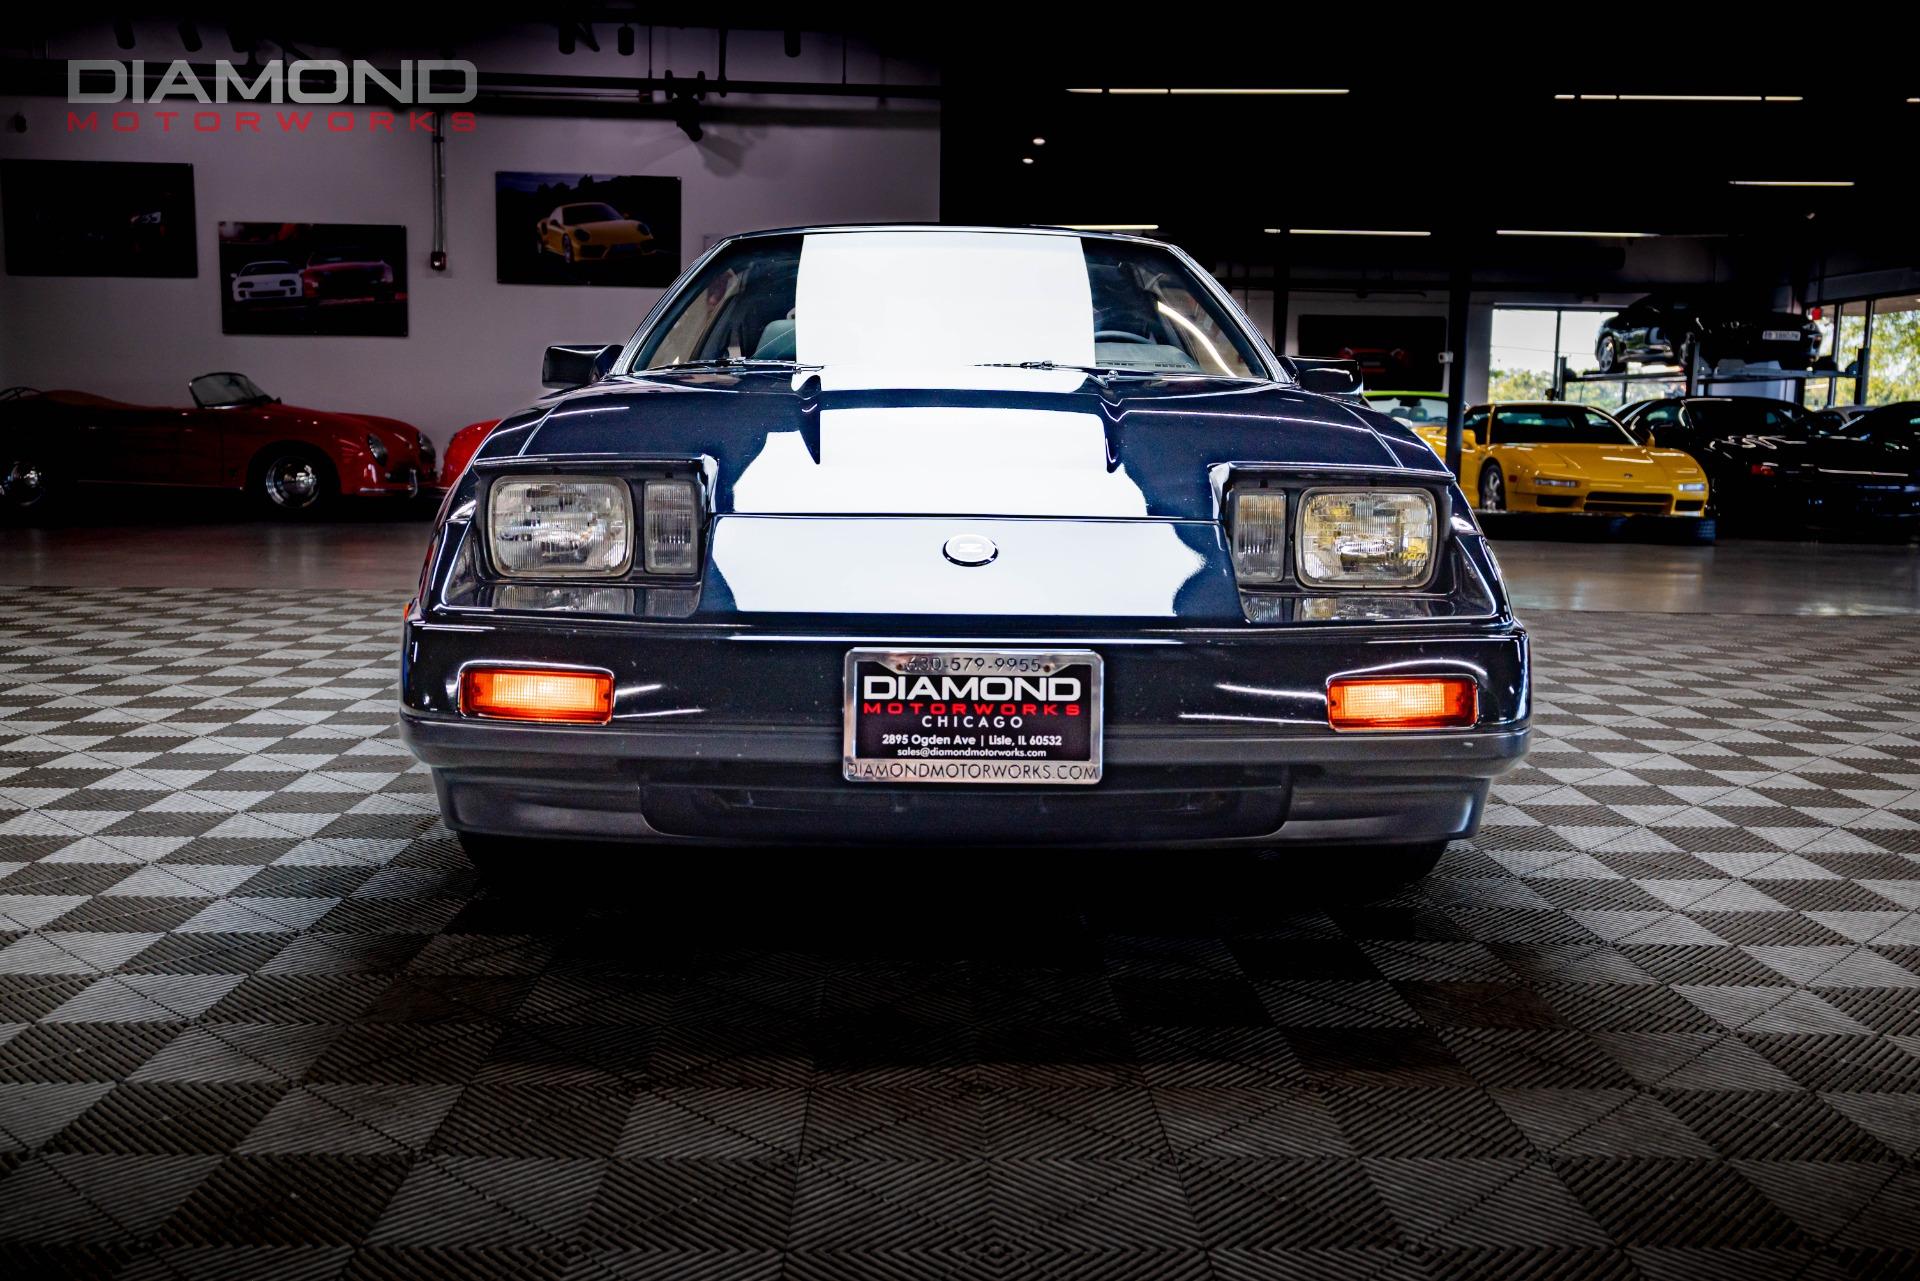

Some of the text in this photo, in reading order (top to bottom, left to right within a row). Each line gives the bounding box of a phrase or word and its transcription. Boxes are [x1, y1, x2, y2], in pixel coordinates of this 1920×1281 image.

[906, 656, 1041, 673] 630-579-9955
[863, 675, 1081, 701] DIAMOND
[863, 702, 1081, 716] MOTORWORKS
[921, 715, 1023, 728] CHICAGO
[881, 734, 909, 745] 2895
[911, 734, 951, 747] Ogden
[953, 735, 976, 745] Ave
[988, 735, 1015, 746] Lisle,
[1017, 735, 1028, 745] IL
[1029, 735, 1062, 746] 60532
[897, 746, 1047, 758] sales@diamondmotorworks.com
[847, 762, 1099, 780] DIAMONDMOTORWORKS.COM
